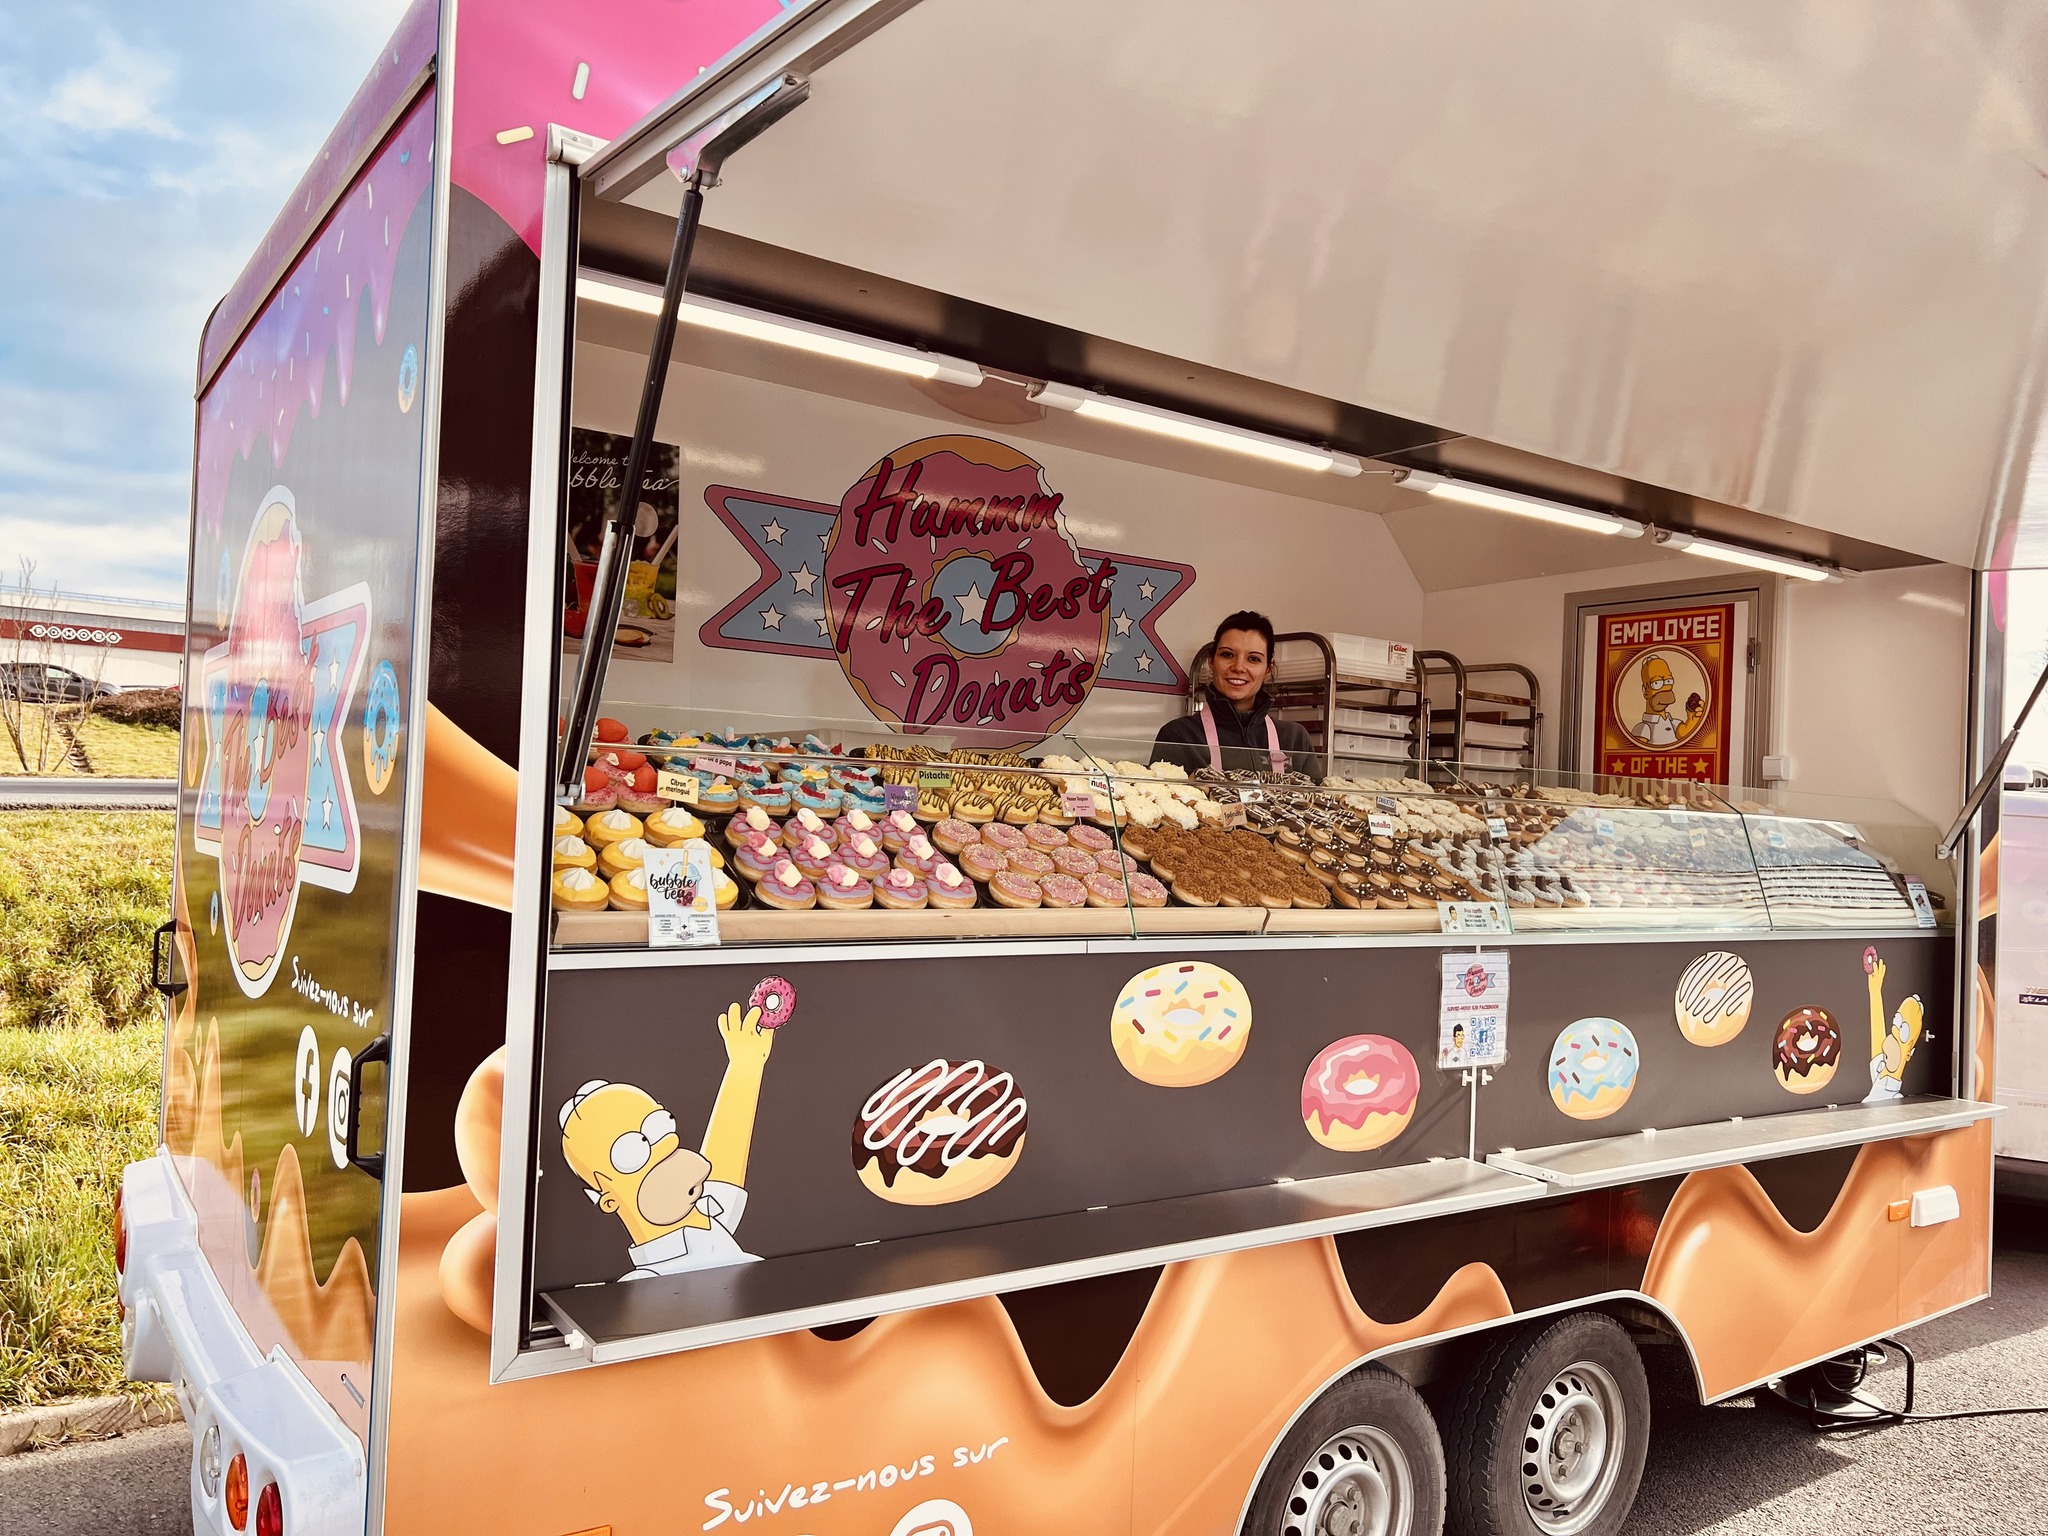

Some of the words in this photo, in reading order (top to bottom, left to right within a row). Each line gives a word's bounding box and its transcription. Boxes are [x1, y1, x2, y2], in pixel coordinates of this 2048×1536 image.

[570, 449, 618, 465] elcome
[621, 455, 631, 467] t
[832, 563, 952, 653] The
[980, 551, 1118, 635] Best
[30, 624, 122, 645] BONOBO
[1610, 615, 1720, 645] EMPLOYEE
[902, 650, 1094, 735] Donuts
[918, 770, 950, 780] Pistache
[1630, 757, 1652, 775] OF
[1655, 756, 1688, 775] THE
[665, 785, 691, 796] meringué
[669, 778, 687, 788] Citron
[1090, 779, 1115, 793] nutea
[1608, 776, 1711, 802] MONTH
[1371, 820, 1391, 829] nutella
[232, 811, 297, 942] Donuts
[649, 872, 697, 890] bubble
[657, 886, 687, 900] tea
[291, 955, 349, 1018] Suivez-nous
[352, 1001, 374, 1029] sur
[703, 1454, 935, 1531] Suivez-nous
[952, 1436, 1009, 1467] sur
